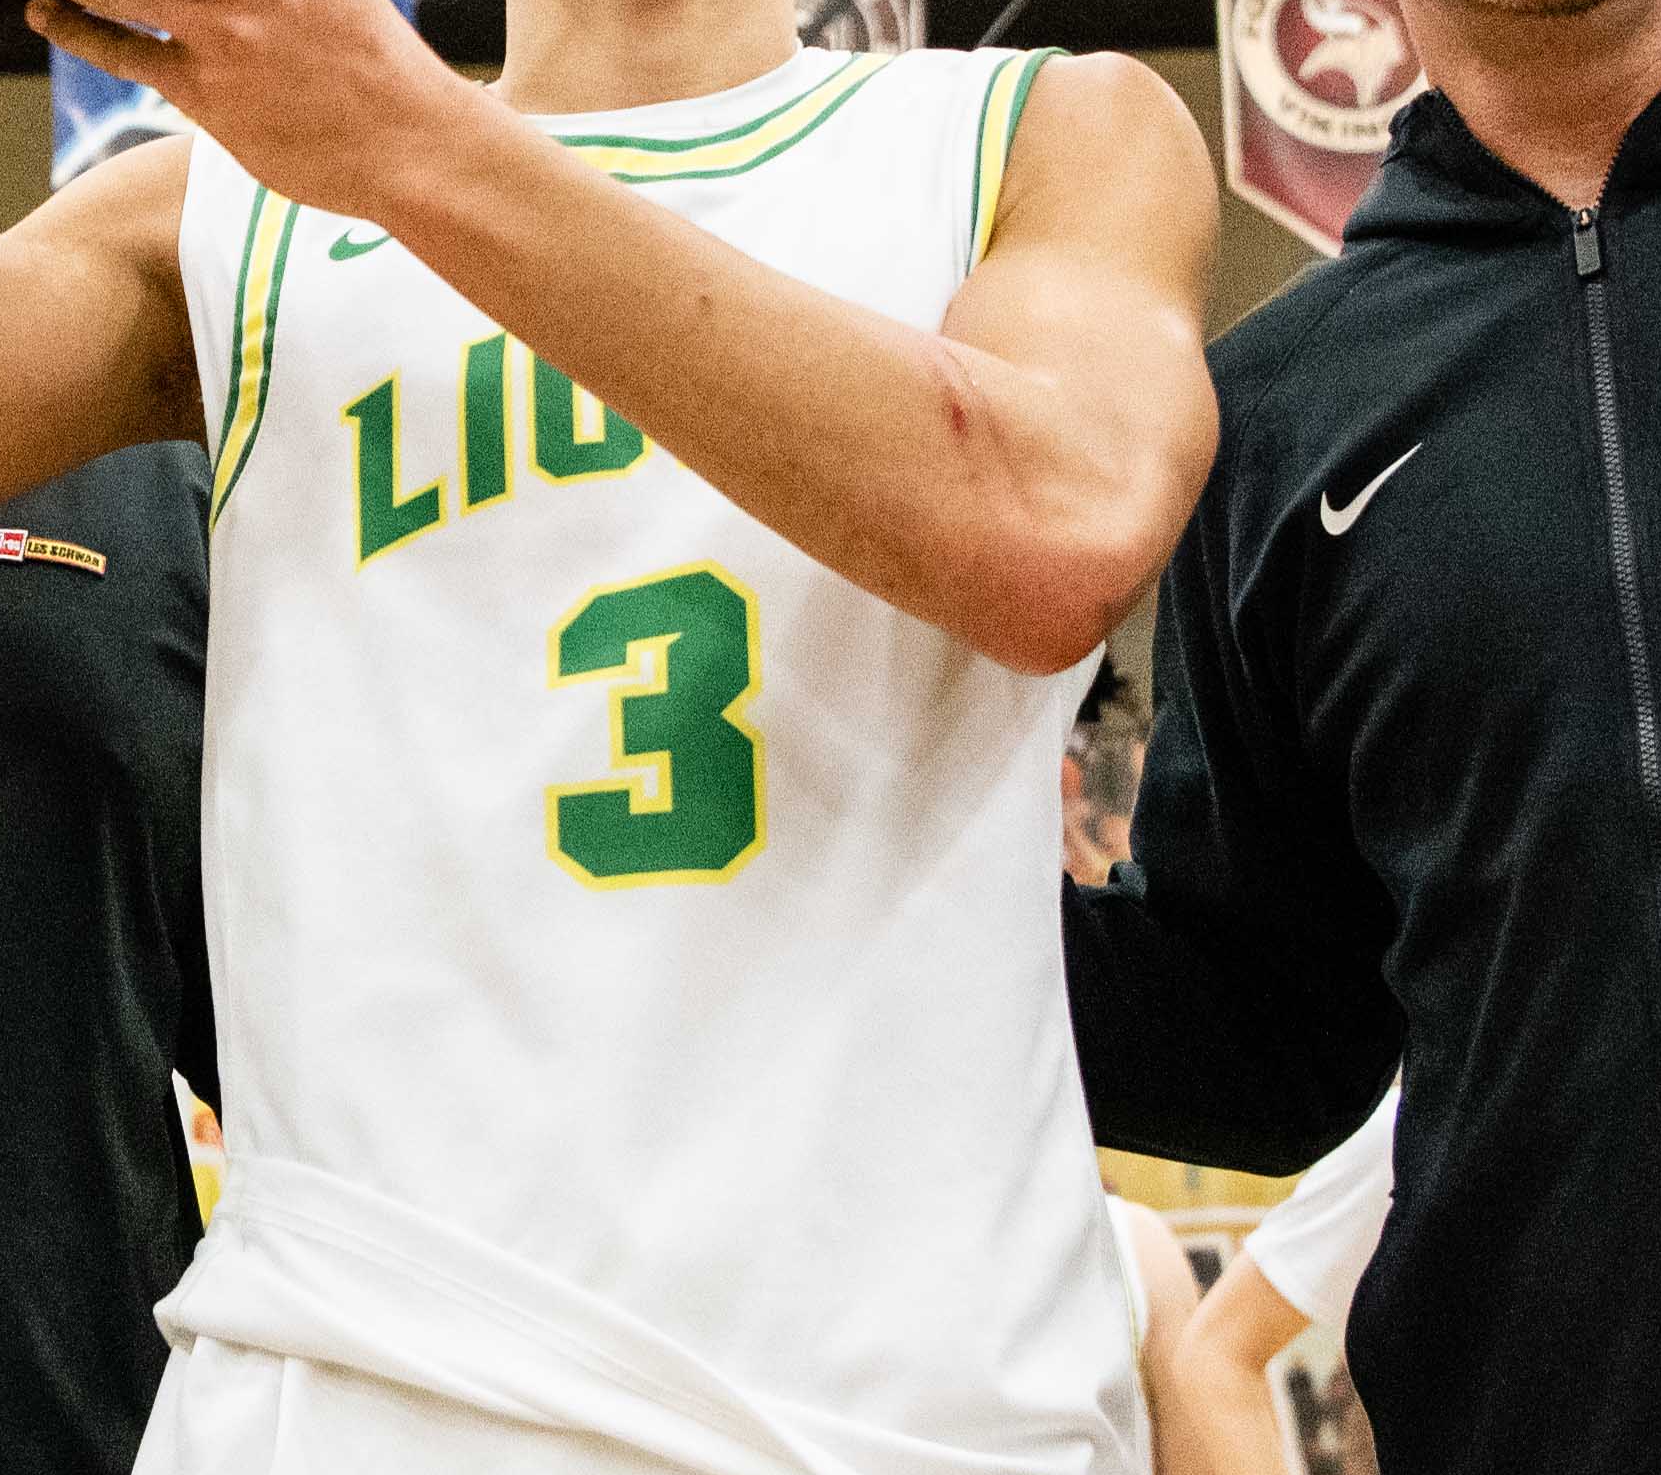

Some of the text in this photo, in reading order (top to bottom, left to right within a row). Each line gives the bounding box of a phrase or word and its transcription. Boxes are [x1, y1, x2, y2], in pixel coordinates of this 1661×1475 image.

[27, 541, 48, 554] LES
[49, 545, 100, 567] SCHWAB
[340, 331, 655, 573] LIO
[546, 558, 767, 892] 3
